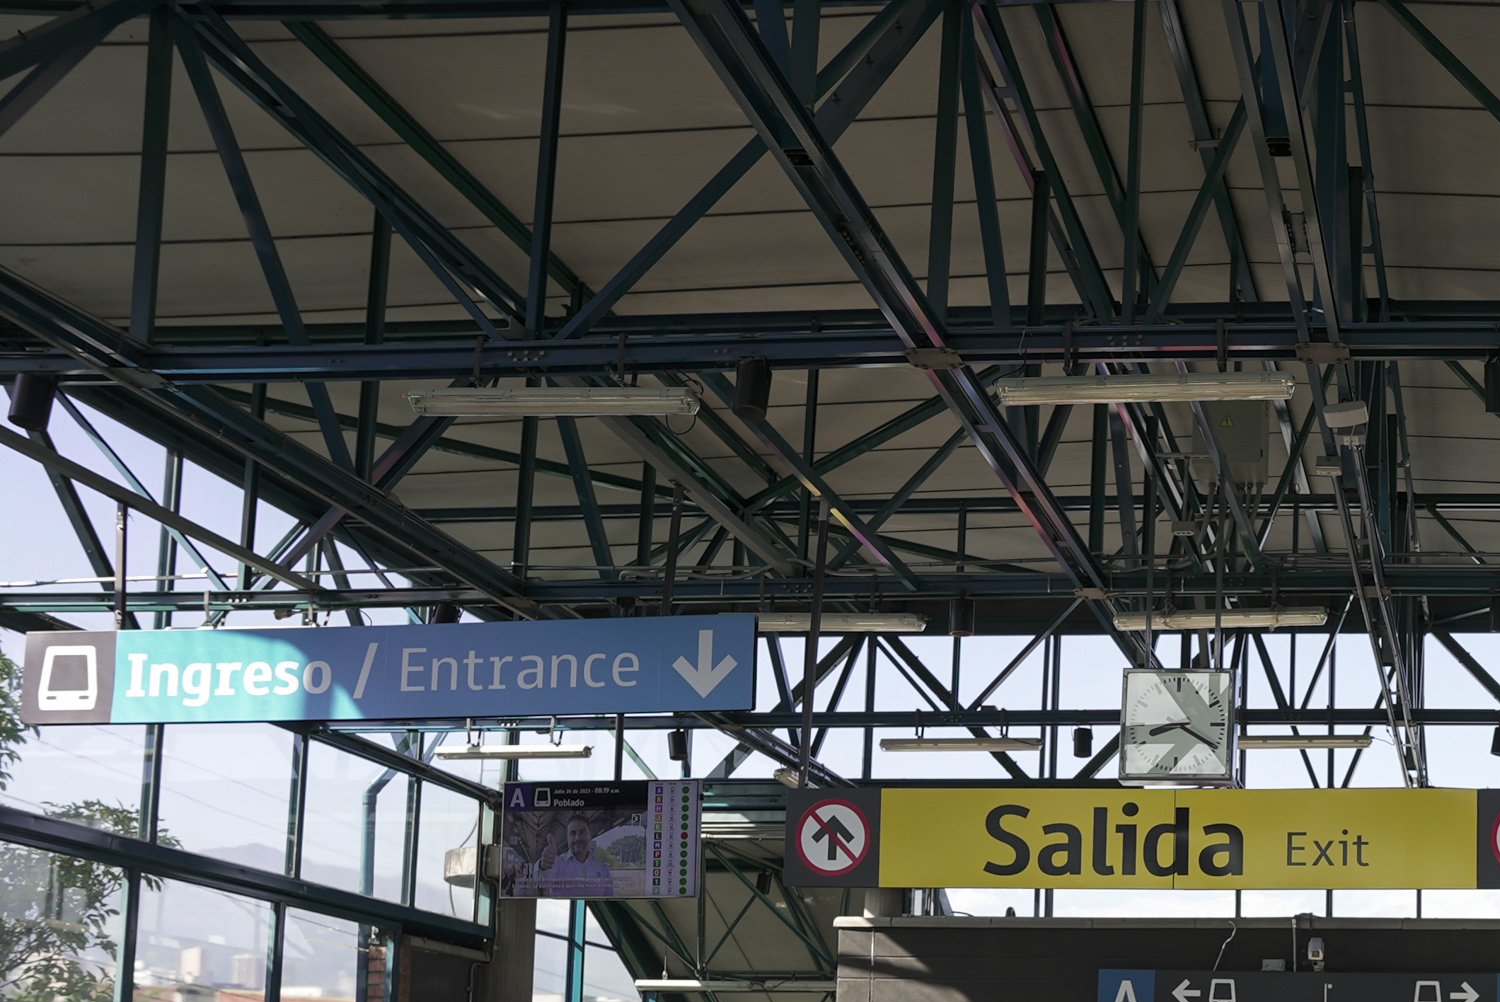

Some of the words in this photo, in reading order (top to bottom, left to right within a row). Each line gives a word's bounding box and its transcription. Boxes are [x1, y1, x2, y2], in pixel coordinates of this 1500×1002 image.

[126, 653, 331, 707] Ingreso
[400, 646, 640, 692] Entrance
[510, 788, 525, 807] A
[984, 801, 1244, 877] Salida
[1286, 831, 1369, 868] Exit
